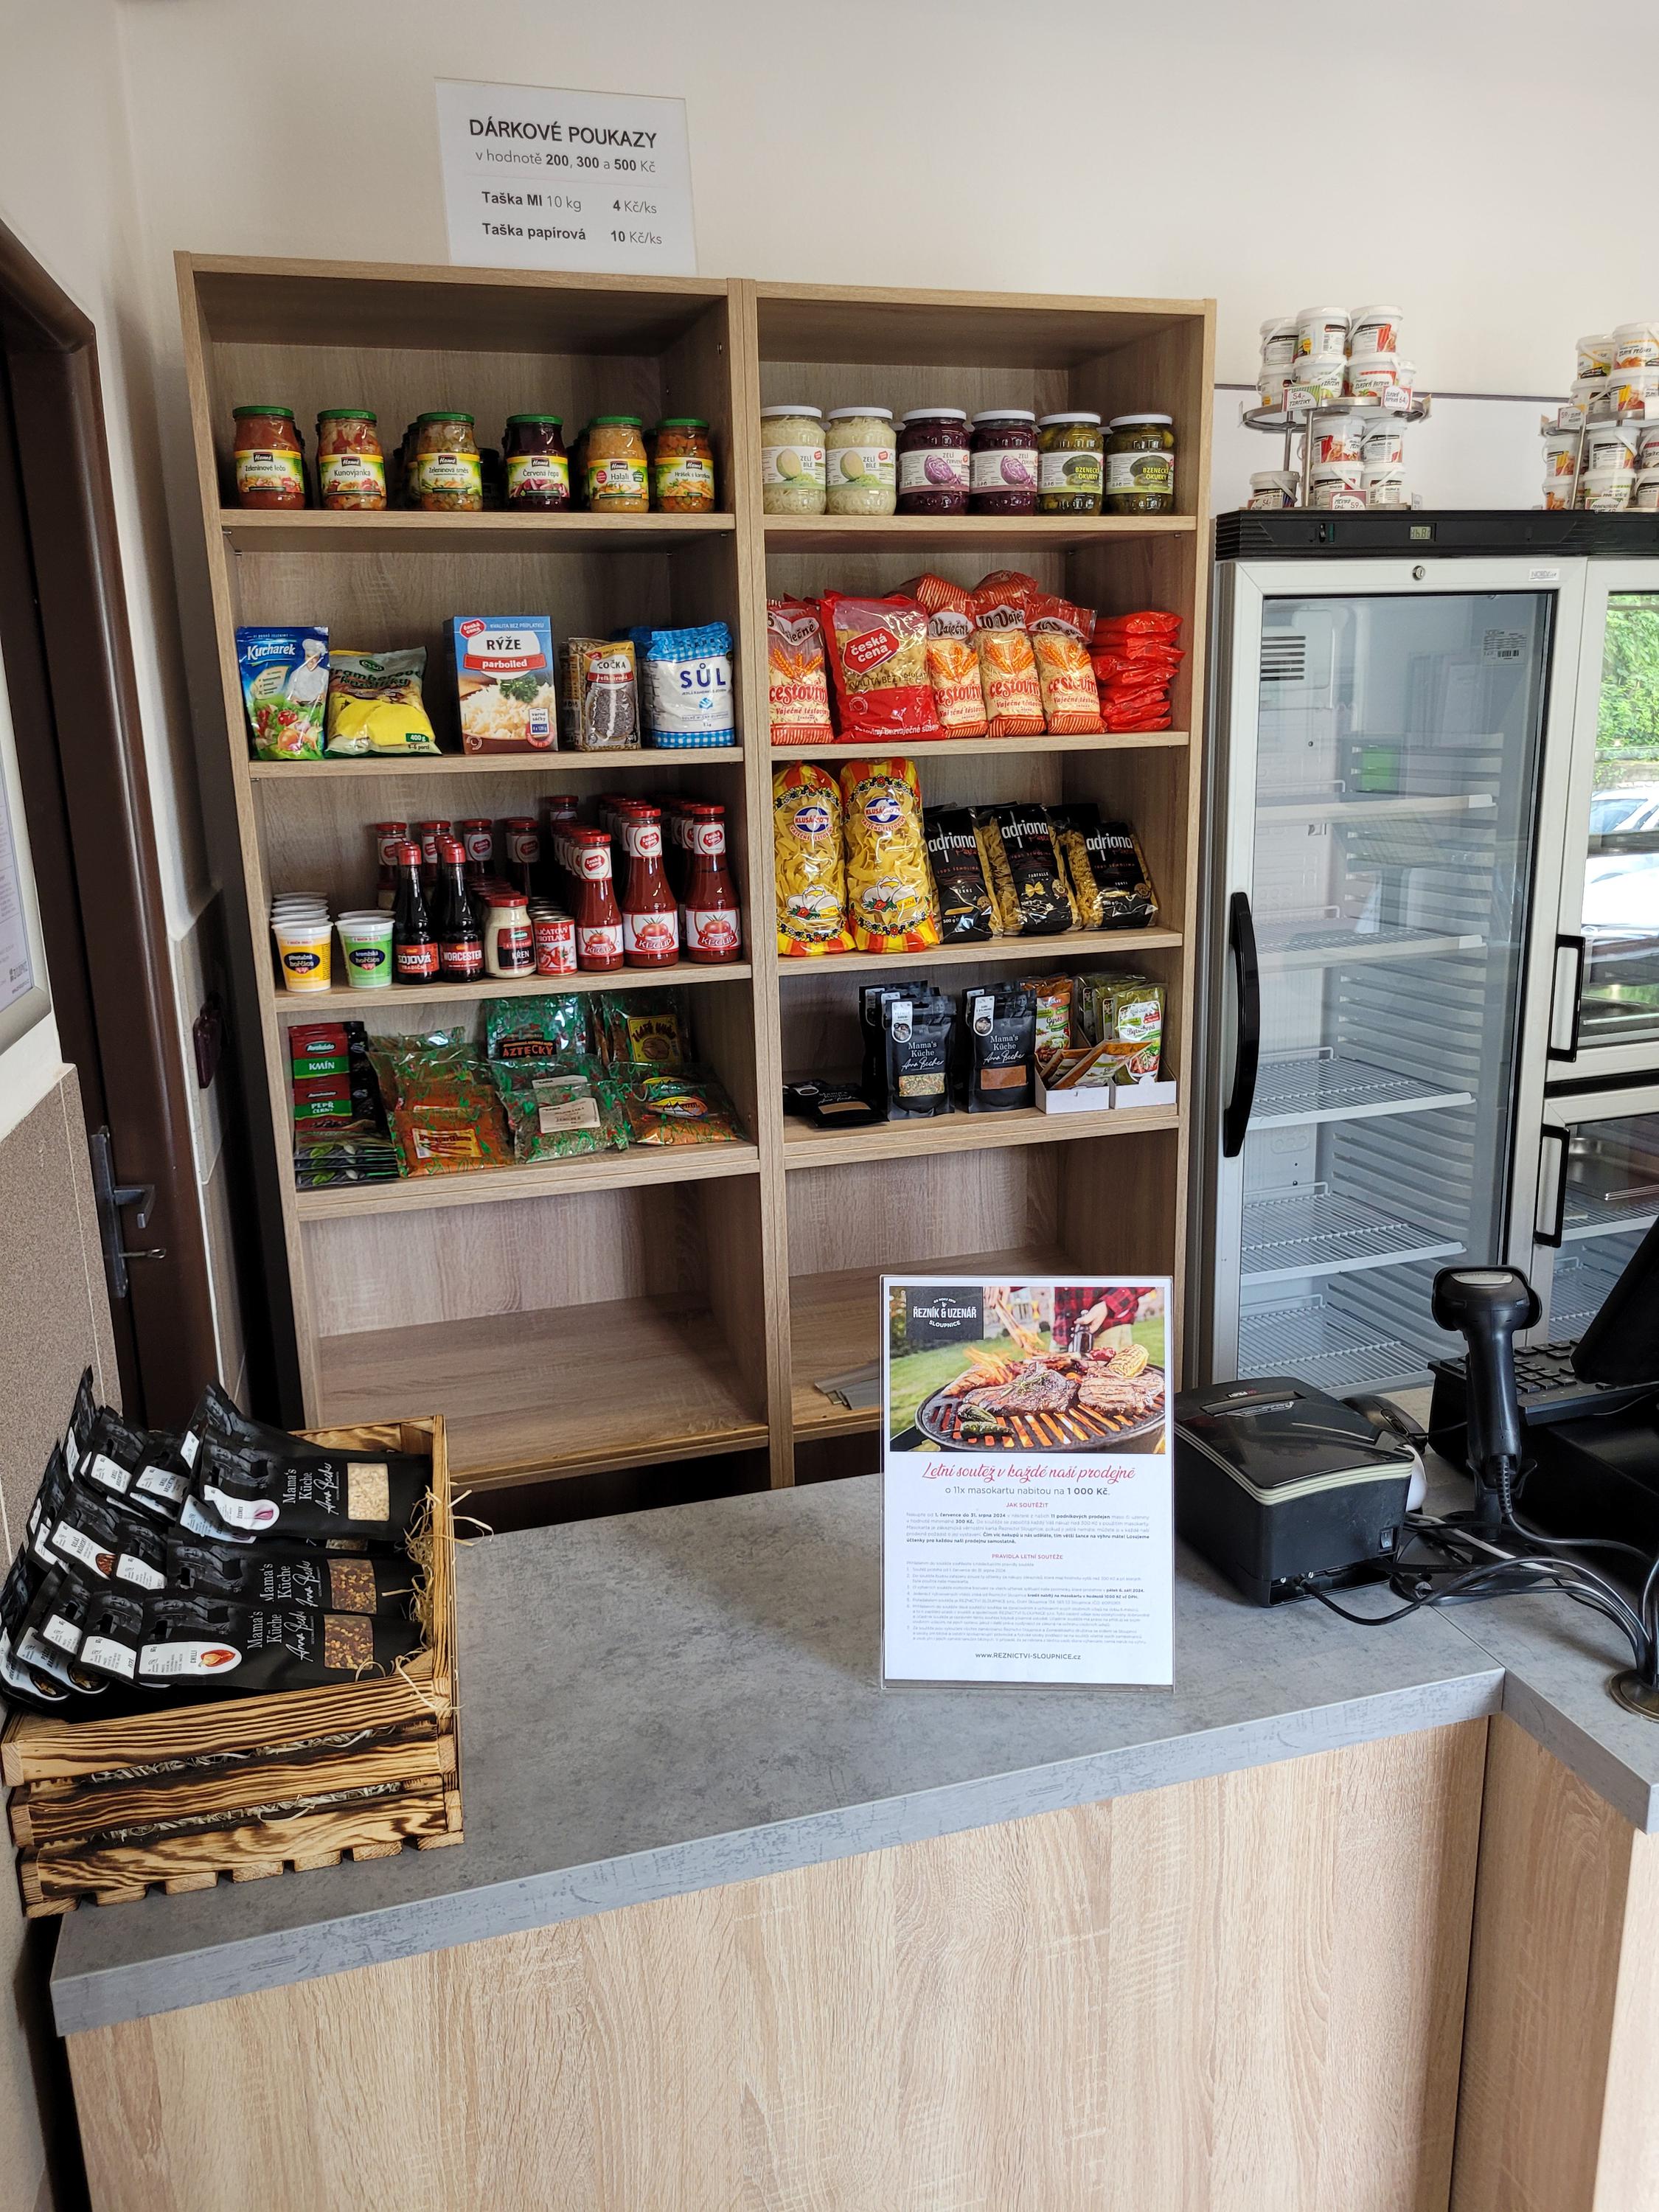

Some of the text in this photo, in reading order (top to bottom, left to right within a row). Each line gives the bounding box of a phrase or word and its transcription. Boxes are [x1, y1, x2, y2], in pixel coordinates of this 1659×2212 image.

[469, 116, 657, 149] DÁRKOVÉ POUKAZY
[476, 149, 656, 173] v hodnotě 200, 300 a 500 Kč
[481, 191, 657, 215] Taška MI 10 kg 4 Kč/ks
[481, 223, 663, 245] Taška papírová 10 Kč/ks
[247, 642, 296, 661] Kucharek
[487, 636, 522, 650] RÝŽE
[851, 633, 888, 655] česká
[858, 644, 889, 663] cena
[482, 659, 527, 669] parboiled
[681, 663, 726, 689] SŮL
[1048, 675, 1097, 695] cestovin
[769, 682, 827, 703] cestovin
[934, 683, 981, 706] cestovin
[990, 677, 1040, 699] cestovin
[1001, 817, 1048, 843] adriana
[928, 827, 977, 856] adriana
[1086, 829, 1133, 855] adriana
[444, 950, 482, 961] WORCESTER
[512, 950, 529, 959] KŘEN
[911, 1048, 934, 1057] Küche
[993, 1042, 1016, 1051] Küche
[309, 1061, 335, 1071] KMÍN
[913, 1306, 977, 1318] ŘEZNÍK & UZENÁŘ
[922, 1462, 1136, 1484] Letní soutěž v každé naší prodejně
[299, 1472, 313, 1501] Küche
[968, 1486, 1015, 1495] masokartu
[1018, 1486, 1051, 1495] nabitou
[277, 1565, 291, 1599] Küche
[266, 1613, 282, 1644] Küche
